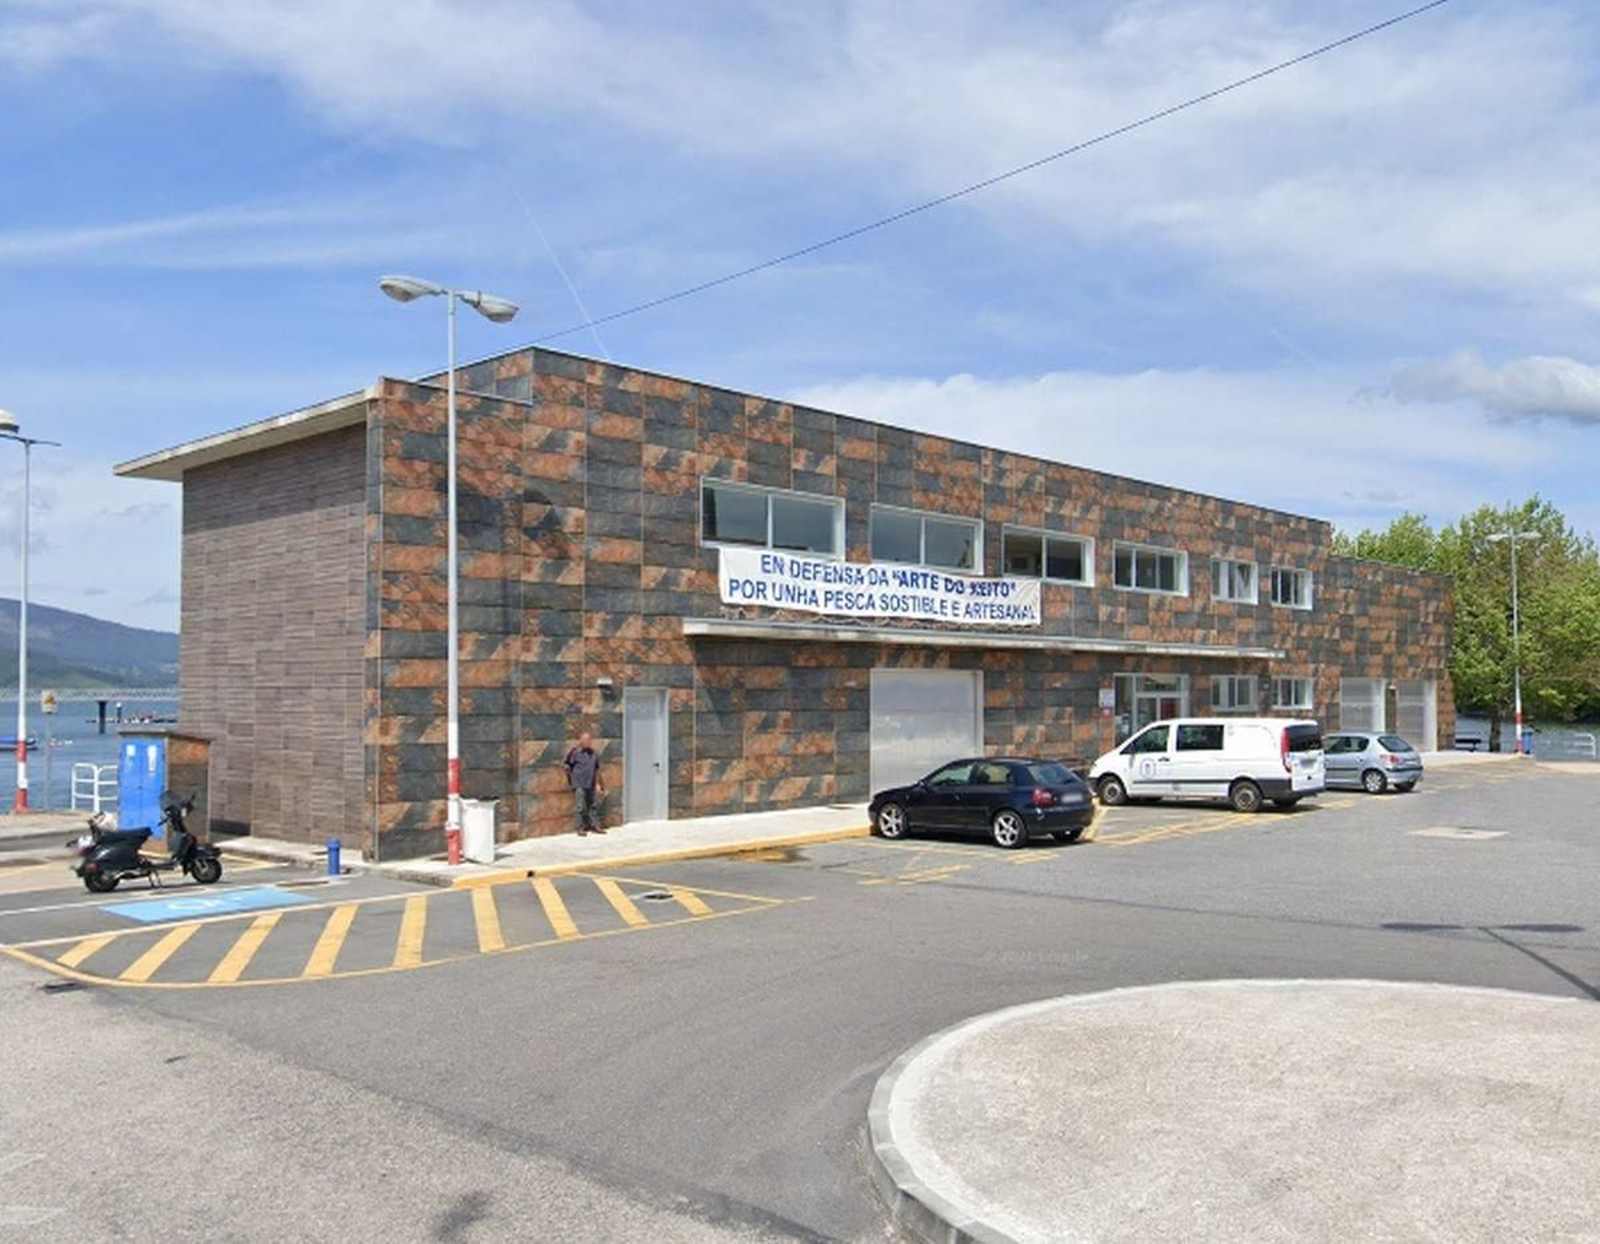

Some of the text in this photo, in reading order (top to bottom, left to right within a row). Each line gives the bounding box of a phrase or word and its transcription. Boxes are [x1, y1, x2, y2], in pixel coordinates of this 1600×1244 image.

[760, 554, 784, 574] EN
[790, 559, 864, 584] DEFENSA
[869, 568, 889, 585] DA
[944, 577, 965, 594] DO
[729, 579, 1036, 620] POR UNHA PESCA SOSTIBLE E ARTESANAL
